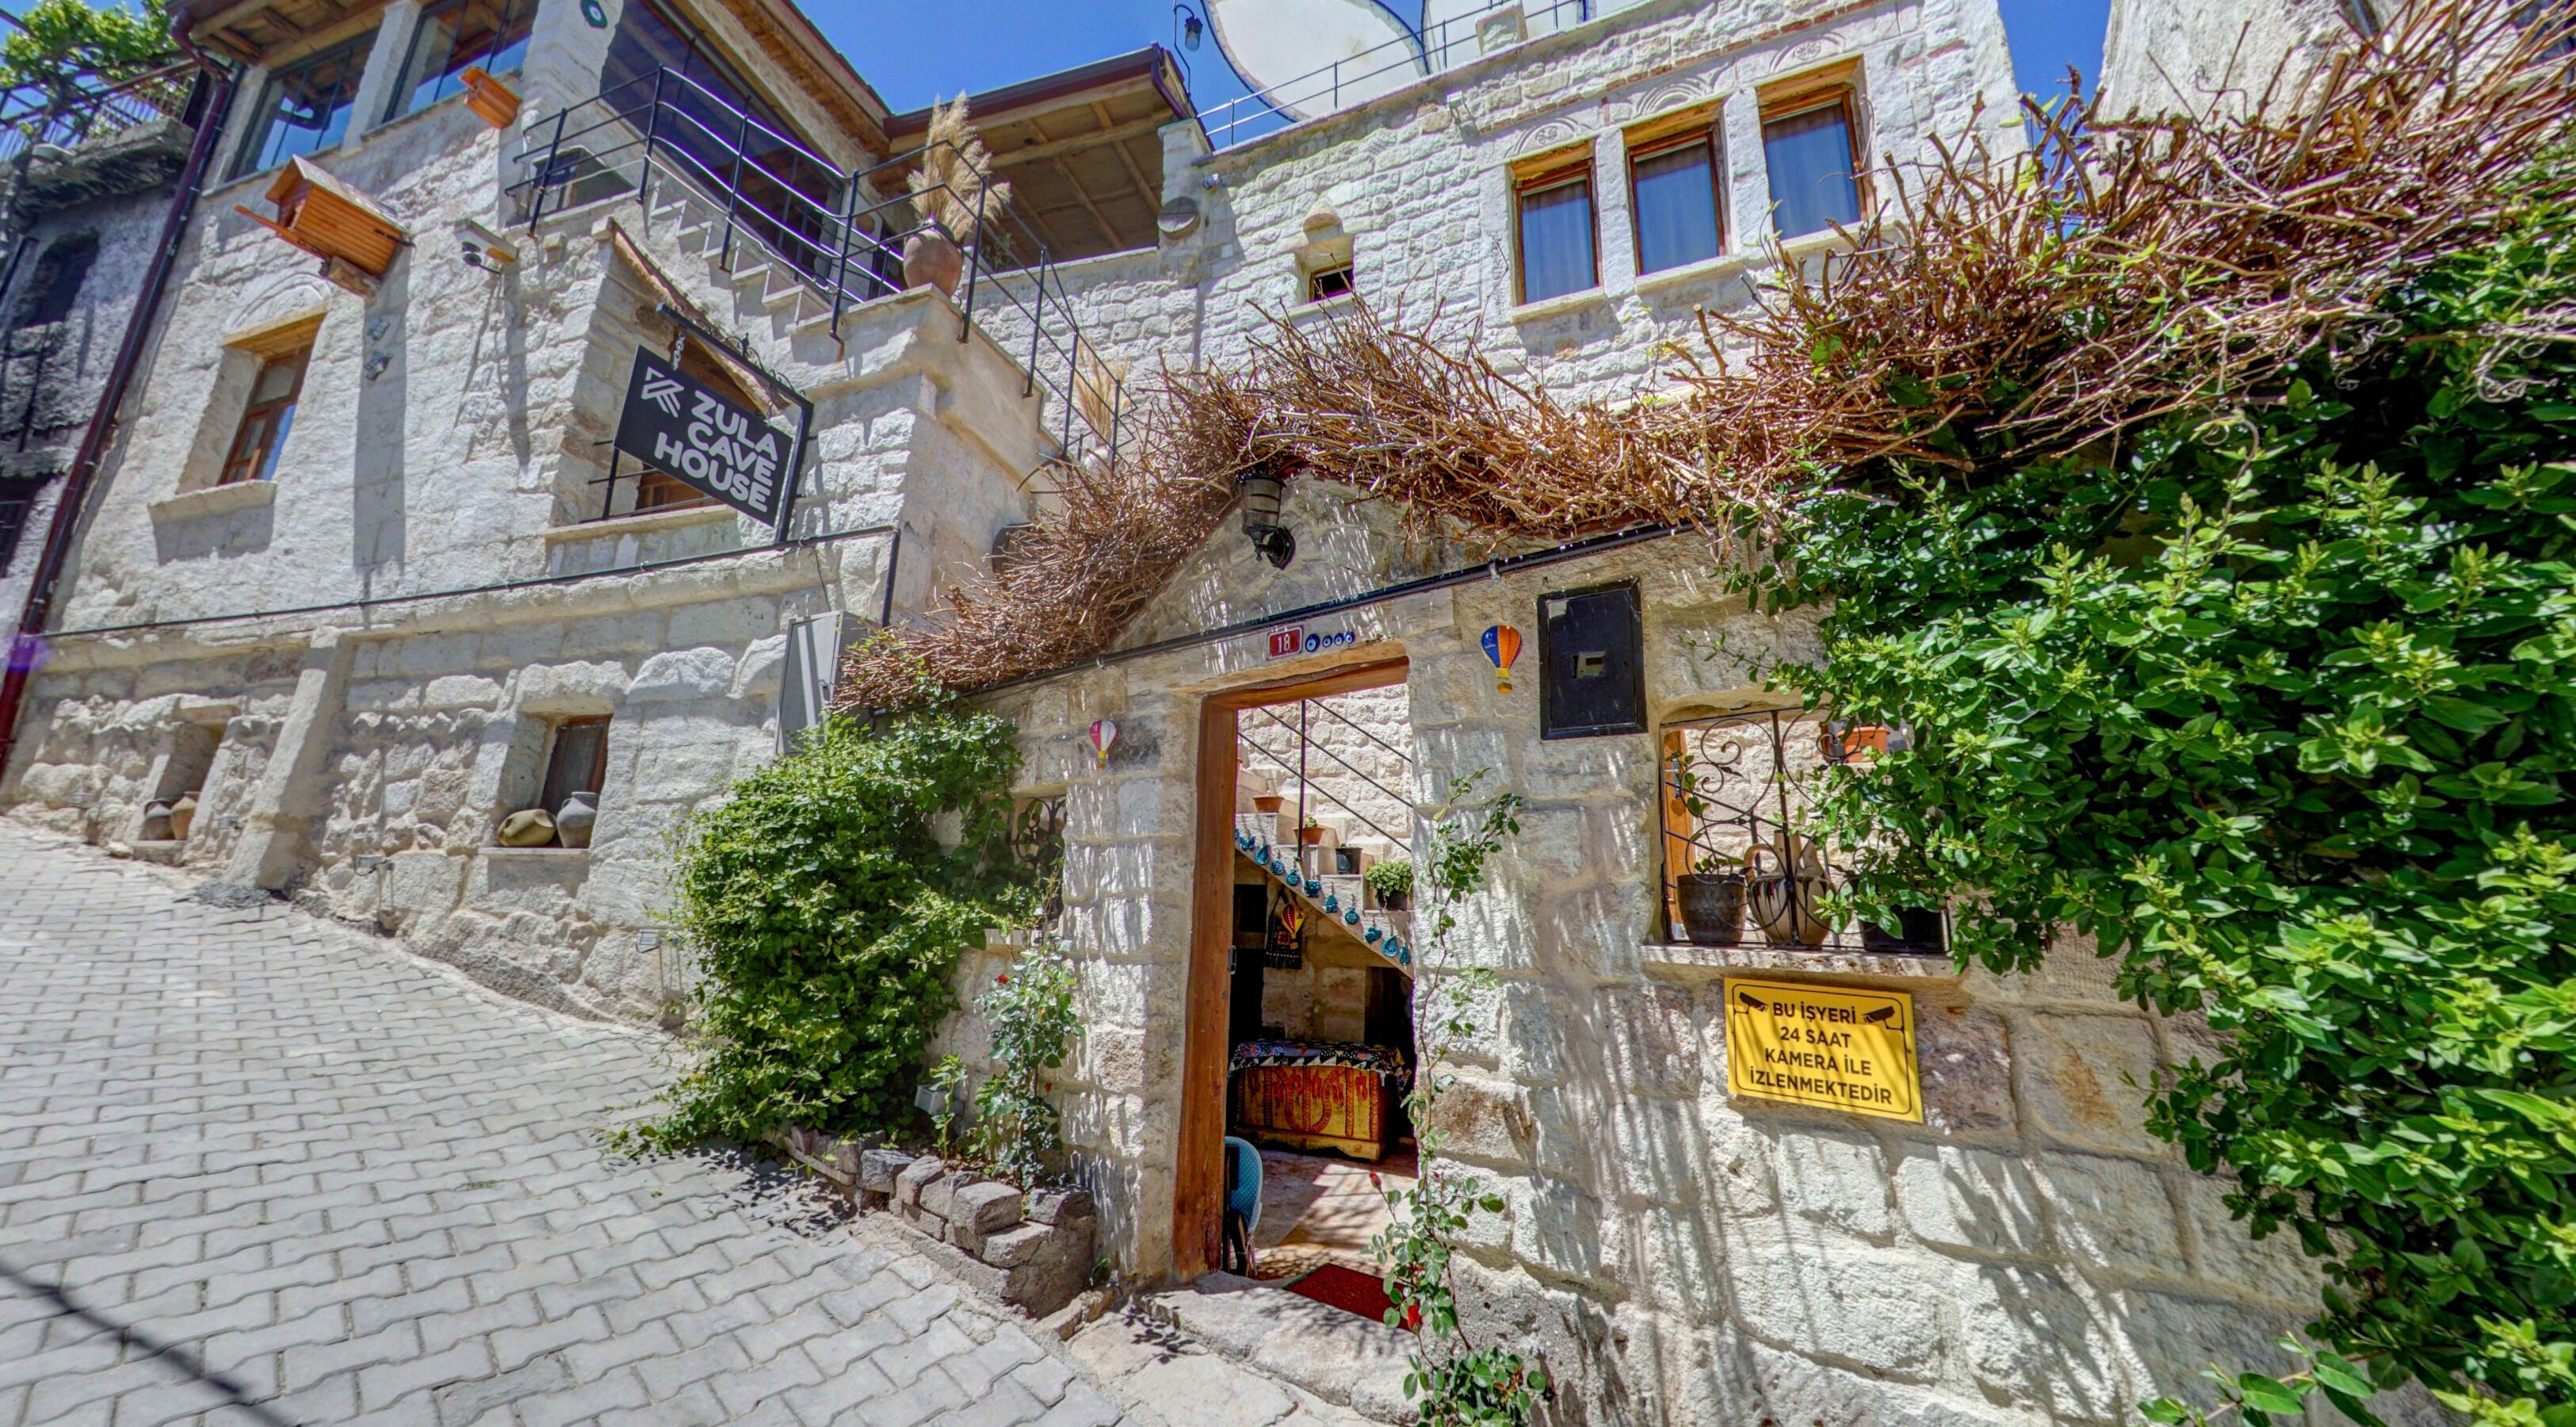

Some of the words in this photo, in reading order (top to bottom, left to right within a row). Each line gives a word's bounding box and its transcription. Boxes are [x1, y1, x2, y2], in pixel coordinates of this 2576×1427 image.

[691, 391, 778, 461] ZULA
[654, 431, 771, 513] HOUSE
[687, 422, 777, 487] CAVE
[1278, 634, 1290, 653] 18
[1773, 1002, 1796, 1017] BU
[1801, 1001, 1856, 1025] İŞYERİ
[1780, 1027, 1801, 1043] 24
[1806, 1030, 1852, 1048] SAAT
[1765, 1047, 1839, 1072] KAMERA
[1844, 1054, 1872, 1077] İLE
[1750, 1065, 1893, 1105] İZLENMEKTEDİR
